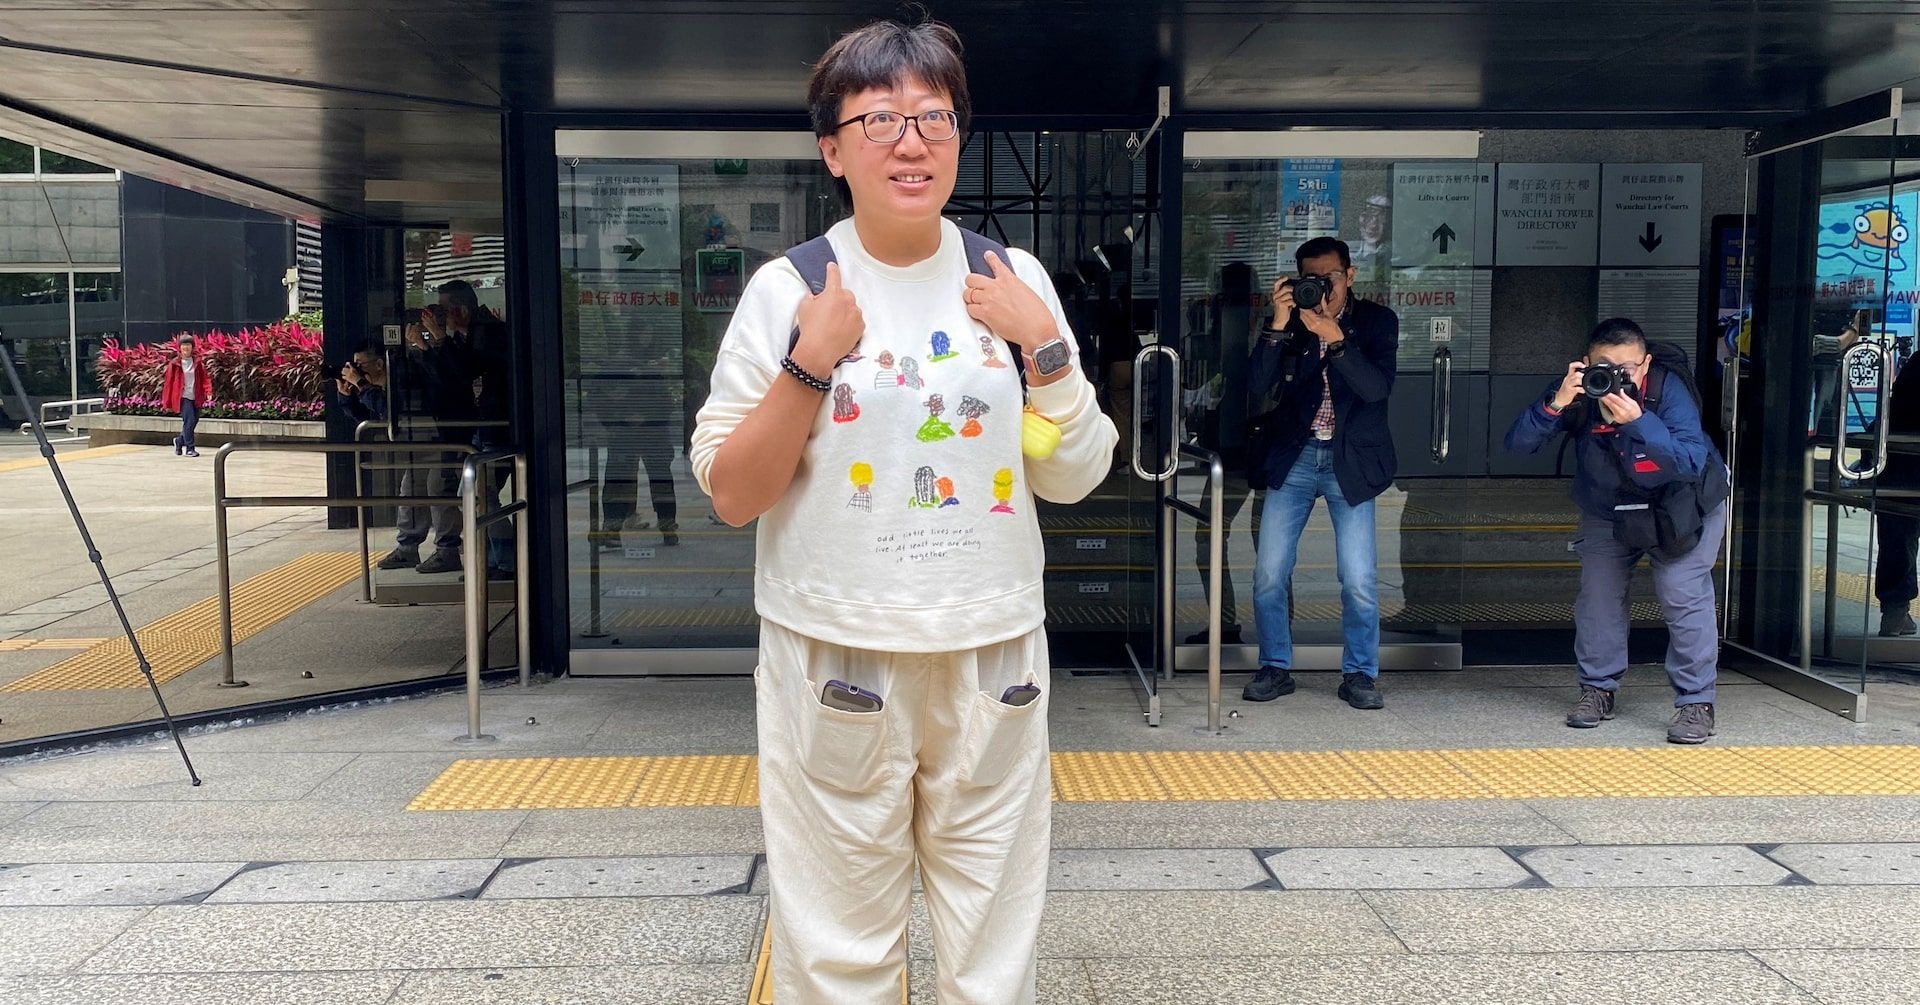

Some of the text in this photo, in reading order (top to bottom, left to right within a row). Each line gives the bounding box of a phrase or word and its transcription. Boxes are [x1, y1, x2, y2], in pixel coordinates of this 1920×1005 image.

[1297, 178, 1328, 190] 5月1日
[1507, 178, 1590, 191] 灣仔政府大樓
[1418, 193, 1435, 201] Lifts
[1445, 193, 1470, 201] Courts
[1521, 192, 1576, 205] 部門指南
[1629, 194, 1663, 202] Directory
[1502, 209, 1594, 218] WANCHAI TOWER
[1517, 221, 1578, 230] DIRECTORY
[712, 257, 729, 265] AED
[579, 291, 680, 306] 灣仔政府大樓
[692, 292, 730, 306] WAN
[1395, 292, 1456, 306] TOWER
[1434, 321, 1446, 334] 拉
[902, 529, 925, 540] little
[909, 540, 929, 550] least
[962, 540, 981, 550] doing
